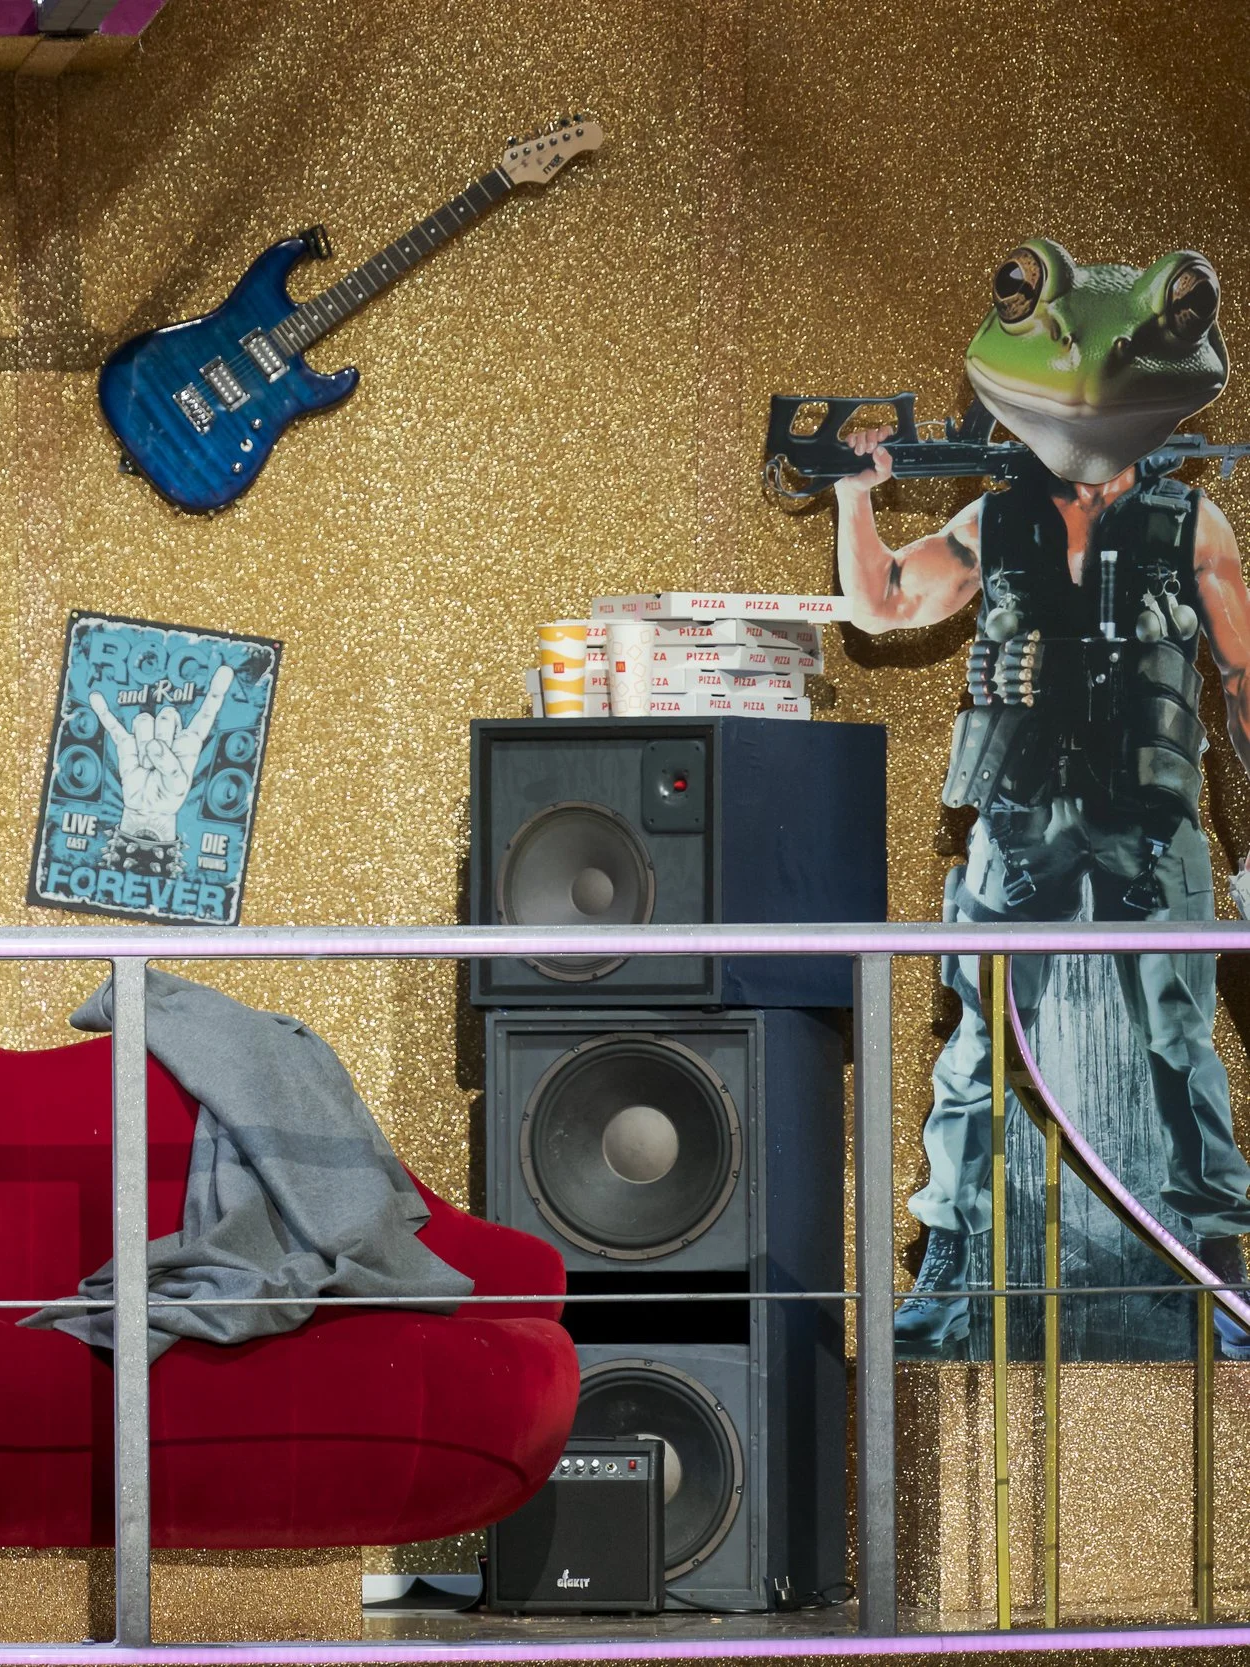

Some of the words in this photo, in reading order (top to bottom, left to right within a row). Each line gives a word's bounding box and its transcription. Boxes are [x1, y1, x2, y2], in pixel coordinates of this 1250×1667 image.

[600, 604, 615, 614] PIZZA
[622, 603, 637, 613] PIZZA
[645, 602, 662, 611] PIZZA
[691, 598, 726, 610] PIZZA
[745, 600, 780, 611] PIZZA
[799, 602, 834, 613] PIZZA
[587, 628, 607, 637] ZZA
[679, 627, 713, 637] PIZZA
[746, 627, 763, 637] PIZZA
[771, 630, 788, 640] PIZZA
[797, 632, 813, 642] PIZZA
[686, 652, 720, 662] PIZZA
[749, 654, 766, 664] PIZZA
[774, 656, 791, 665] PIZZA
[798, 658, 814, 667] PIZZA
[698, 675, 721, 685] PIZZA
[734, 677, 757, 687] PIZZA
[769, 679, 792, 689] PIZZA
[117, 685, 148, 706] and
[154, 679, 195, 704] Roll
[650, 702, 681, 711] PIZZA
[709, 700, 731, 710] PIZZA
[743, 702, 765, 712] PIZZA
[777, 704, 799, 713] PIZZA
[61, 812, 98, 837] LIVE
[200, 832, 229, 856] DIE
[46, 862, 227, 920] FOREVER
